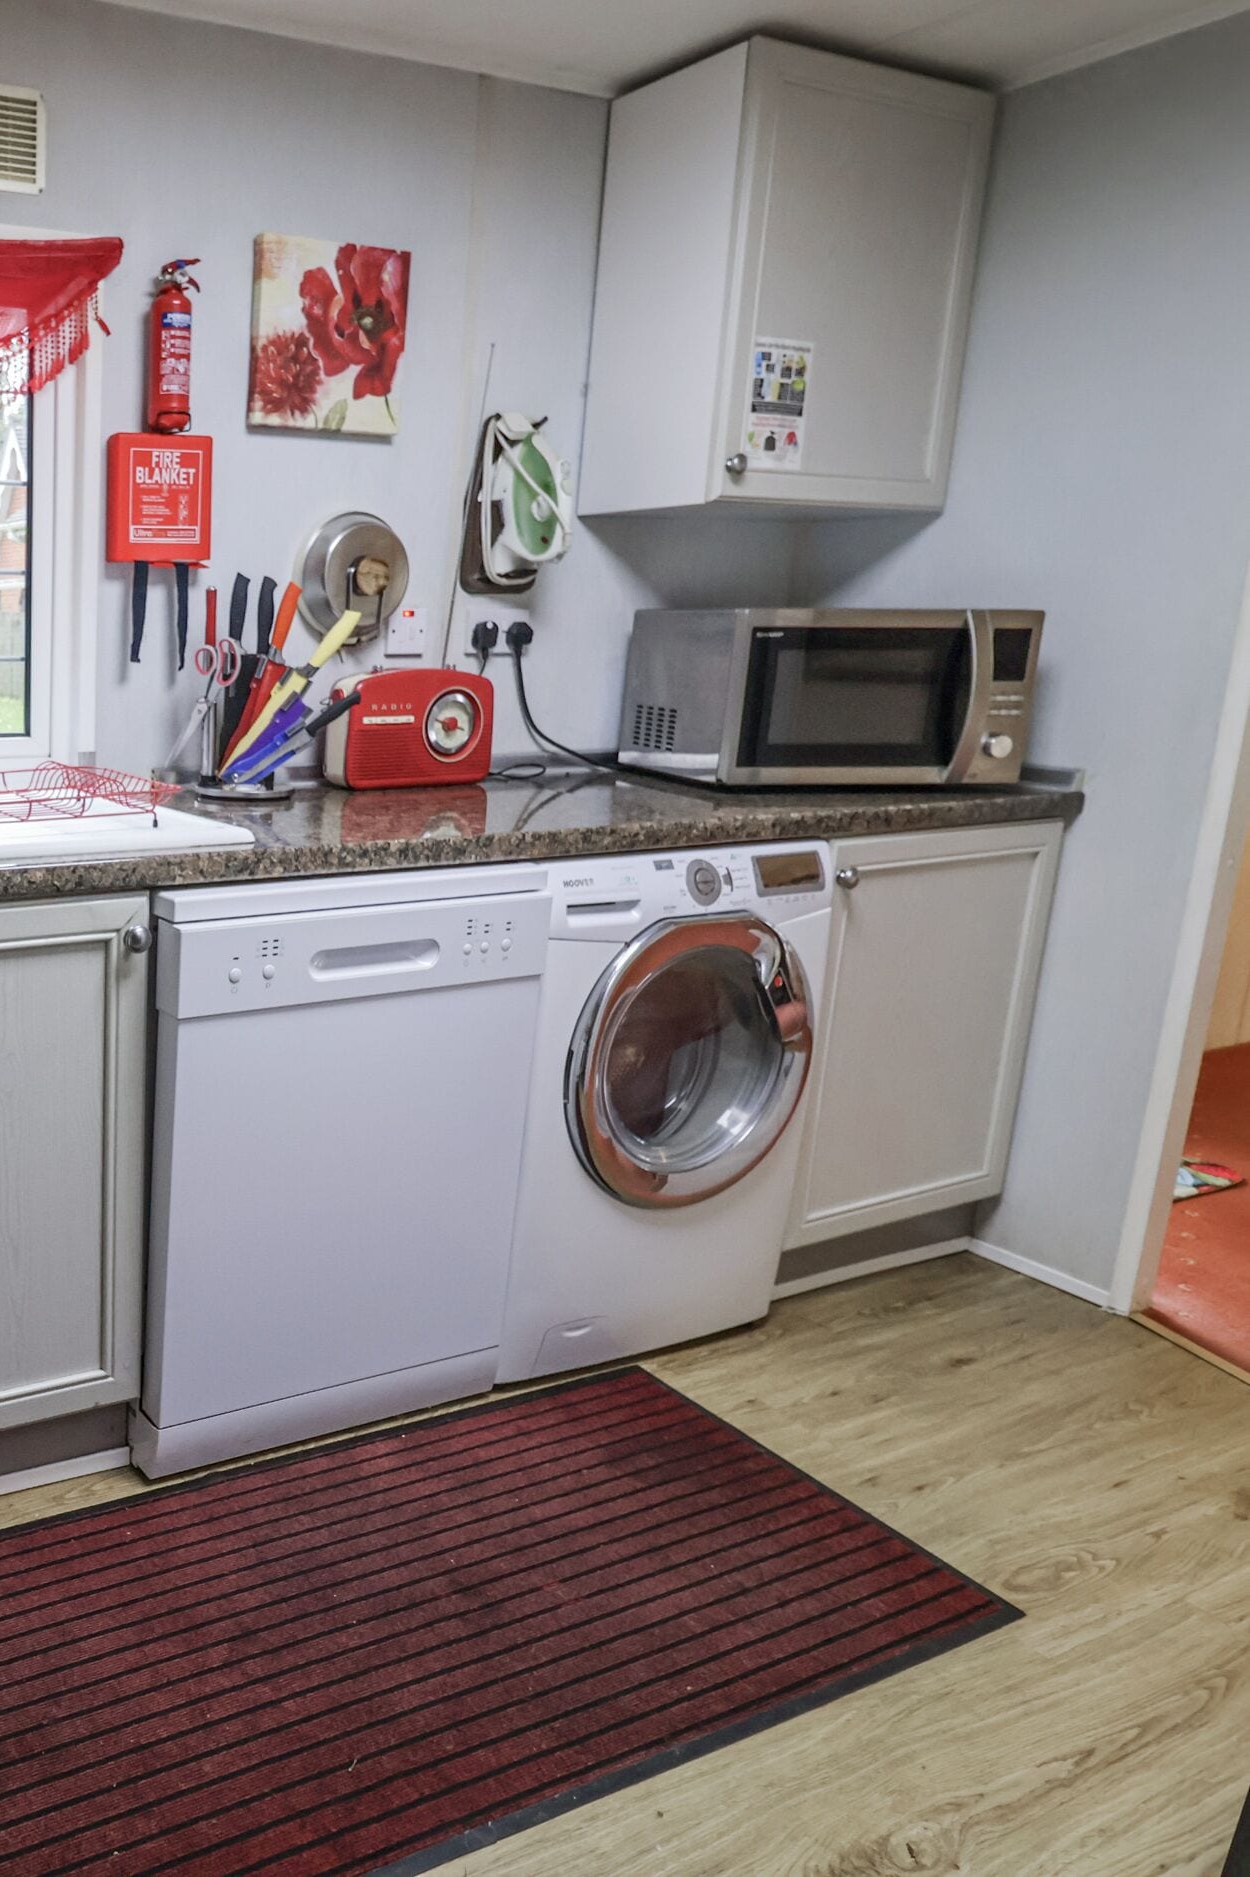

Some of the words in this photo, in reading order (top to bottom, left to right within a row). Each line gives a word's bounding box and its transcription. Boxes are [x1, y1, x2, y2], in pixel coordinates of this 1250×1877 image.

[152, 451, 181, 468] FIRE
[135, 467, 196, 484] BLANKET
[372, 703, 412, 711] RADIO
